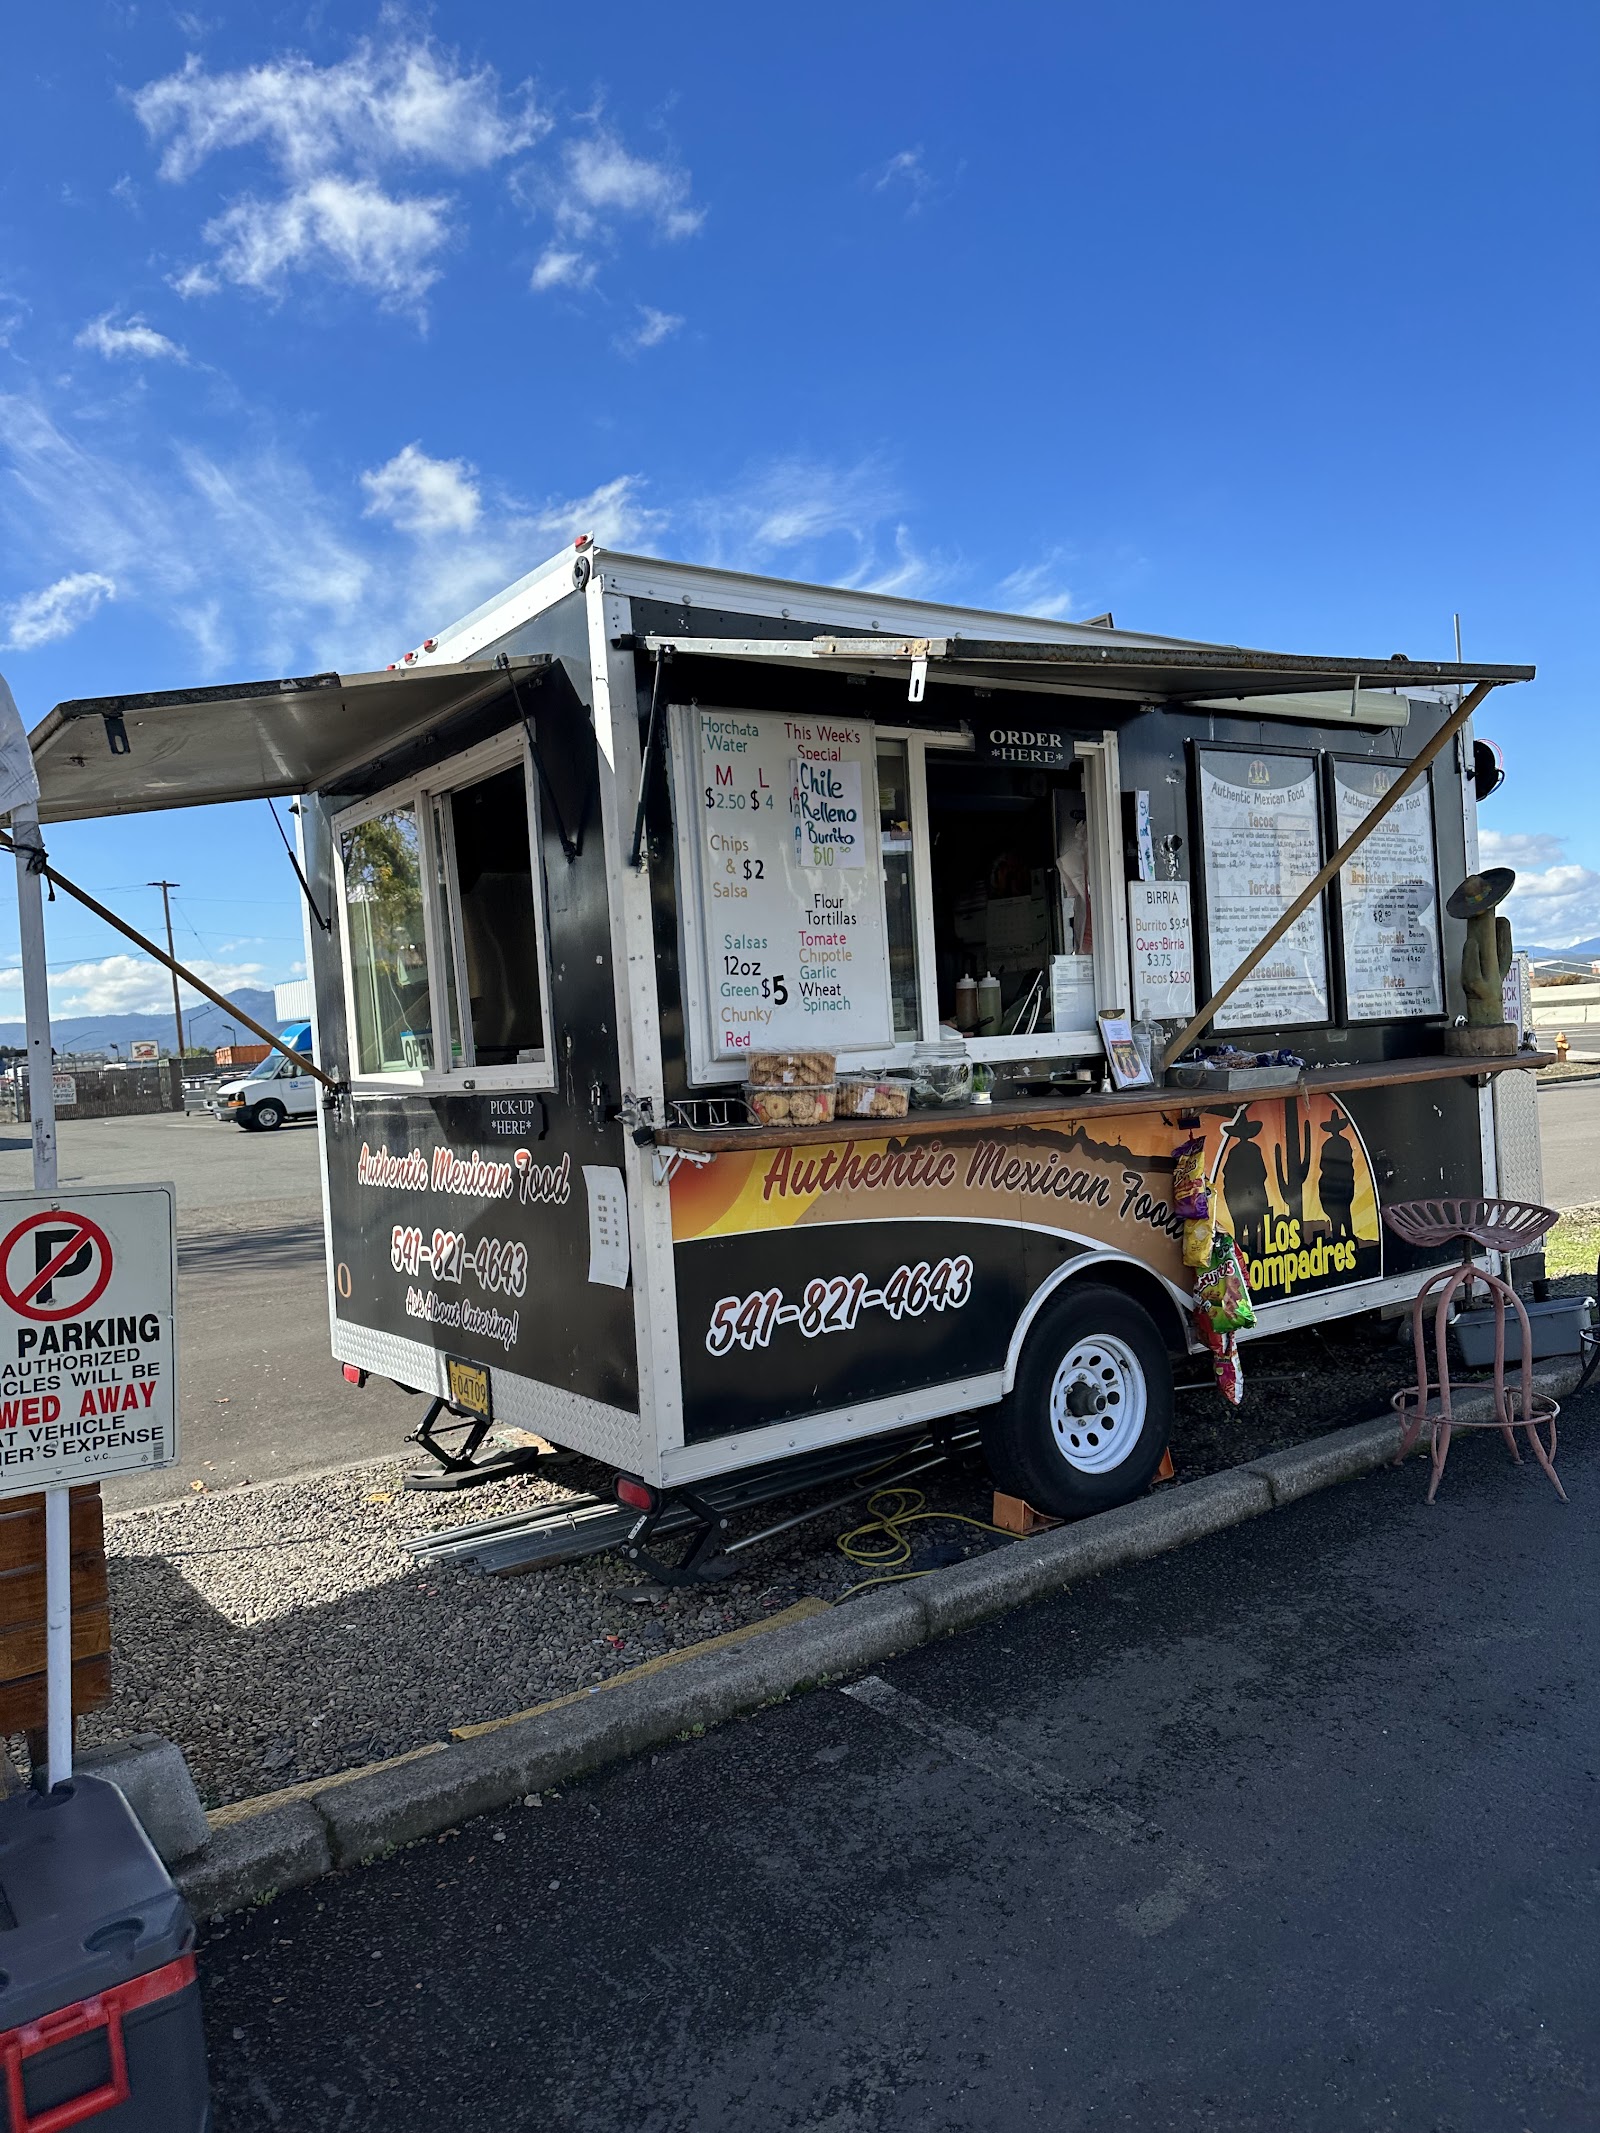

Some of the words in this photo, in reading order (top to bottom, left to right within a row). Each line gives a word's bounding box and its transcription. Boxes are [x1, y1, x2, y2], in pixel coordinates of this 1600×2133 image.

[700, 716, 759, 737] Horchata
[784, 722, 812, 741] This
[816, 725, 861, 743] Week's
[706, 734, 748, 753] Water
[989, 729, 1063, 748] ORDER
[797, 744, 841, 762] Special
[716, 765, 733, 786] M
[758, 768, 770, 788] L
[800, 762, 843, 799] Chile
[705, 786, 746, 810] $2.50
[1211, 781, 1251, 804] Authentic
[1253, 792, 1286, 806] Mexican
[1287, 786, 1306, 803] Food
[800, 791, 857, 823] Relleno
[1405, 796, 1421, 811] Food
[1247, 811, 1274, 828] Tacos
[1374, 822, 1400, 833] urritos
[805, 820, 856, 845] Burrito
[710, 834, 749, 854] Chips
[725, 858, 736, 874] &
[743, 859, 764, 881] $2
[713, 881, 748, 898] Salsa
[1247, 879, 1281, 896] Tortas
[814, 893, 844, 909] Flour
[1146, 890, 1180, 905] BIRRIA
[804, 910, 857, 926] Tortillas
[1135, 918, 1168, 932] Burrito
[724, 934, 768, 950] Salsas
[798, 930, 847, 946] Tomate
[723, 955, 761, 976] 12oz
[798, 948, 853, 965] Chipotle
[1147, 953, 1172, 967] $3.75
[800, 965, 837, 980] Garlic
[1140, 970, 1168, 984] Tacos
[1247, 962, 1296, 979] uesadillas
[720, 982, 760, 998] Green
[761, 974, 789, 1006] $5
[798, 981, 842, 997] Wheat
[1502, 986, 1517, 1001] OCK
[802, 996, 851, 1014] Spinach
[1504, 1006, 1519, 1021] EWAY
[721, 1006, 773, 1025] Chunky
[725, 1030, 751, 1048] Red
[405, 1038, 435, 1068] OPEN
[490, 1099, 535, 1115] PICK-UP
[358, 1142, 428, 1191] Authentic
[431, 1146, 514, 1199] Mexican
[514, 1148, 571, 1205] Food
[763, 1139, 957, 1201] Authentic
[967, 1140, 1111, 1207] Mexican
[1263, 1214, 1301, 1254] Los
[391, 1225, 528, 1298] 541-821-4643
[706, 1255, 974, 1356] 541-821-4643
[405, 1285, 425, 1319] Ask
[424, 1290, 460, 1328] About
[461, 1298, 520, 1352] Catering!
[17, 1313, 160, 1358] PARKING
[1, 1347, 141, 1379] AUTHORIZED
[70, 1367, 123, 1387] WILL
[132, 1361, 160, 1379] BE
[79, 1380, 157, 1418] AWAY
[457, 1375, 486, 1404] 04709
[28, 1414, 126, 1443] VEHICLE
[0, 1443, 57, 1467] ER'S
[62, 1426, 164, 1456] EXPENSE
[84, 1452, 112, 1463] C.V.C.
